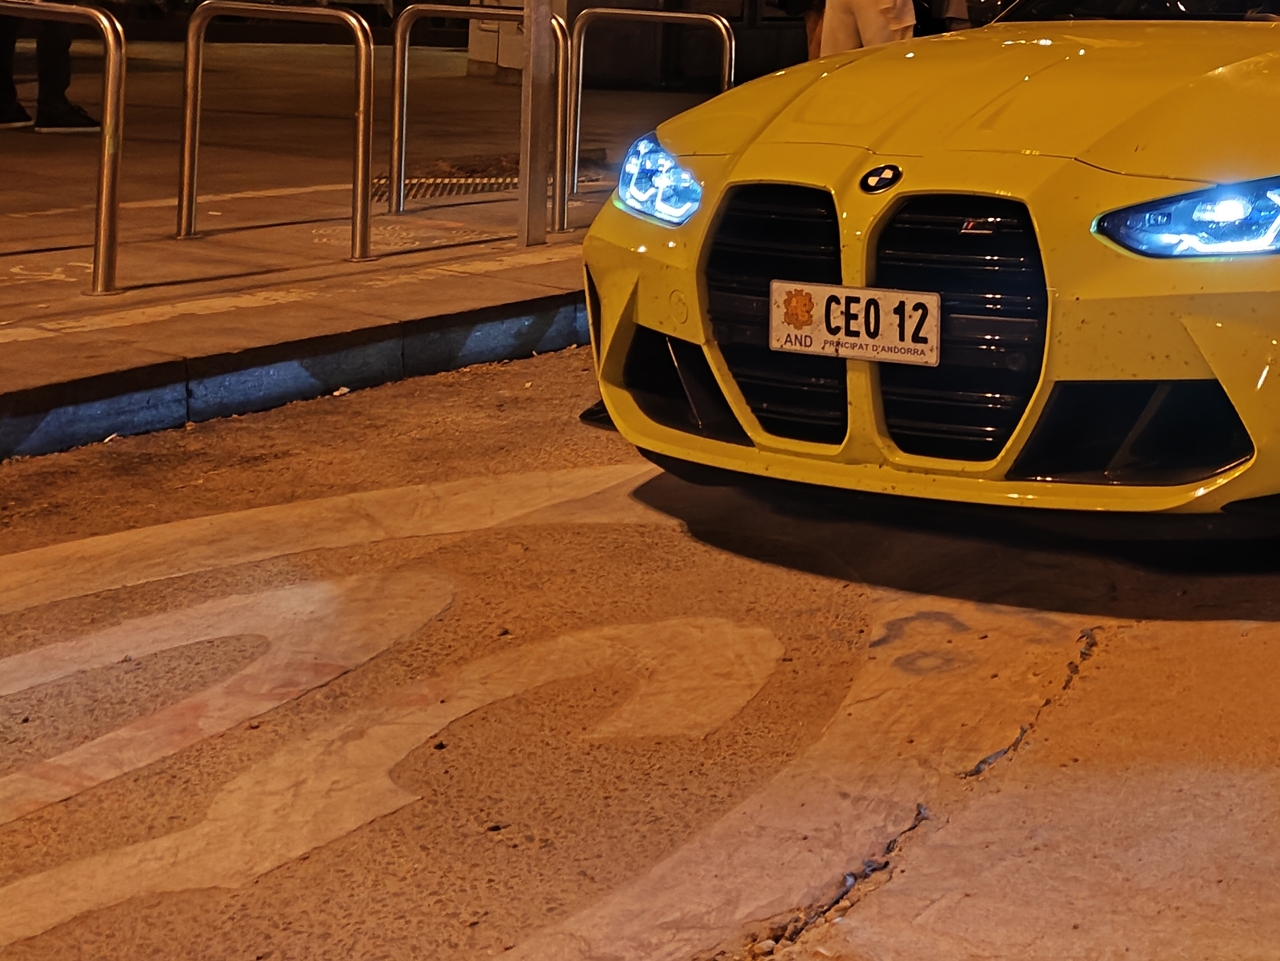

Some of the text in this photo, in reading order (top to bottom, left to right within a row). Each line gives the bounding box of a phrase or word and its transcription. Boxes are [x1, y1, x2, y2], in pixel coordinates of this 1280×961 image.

[893, 300, 929, 345] 12
[783, 333, 813, 348] AND
[823, 339, 926, 357] PRINCIPAT D'ANDORRA
